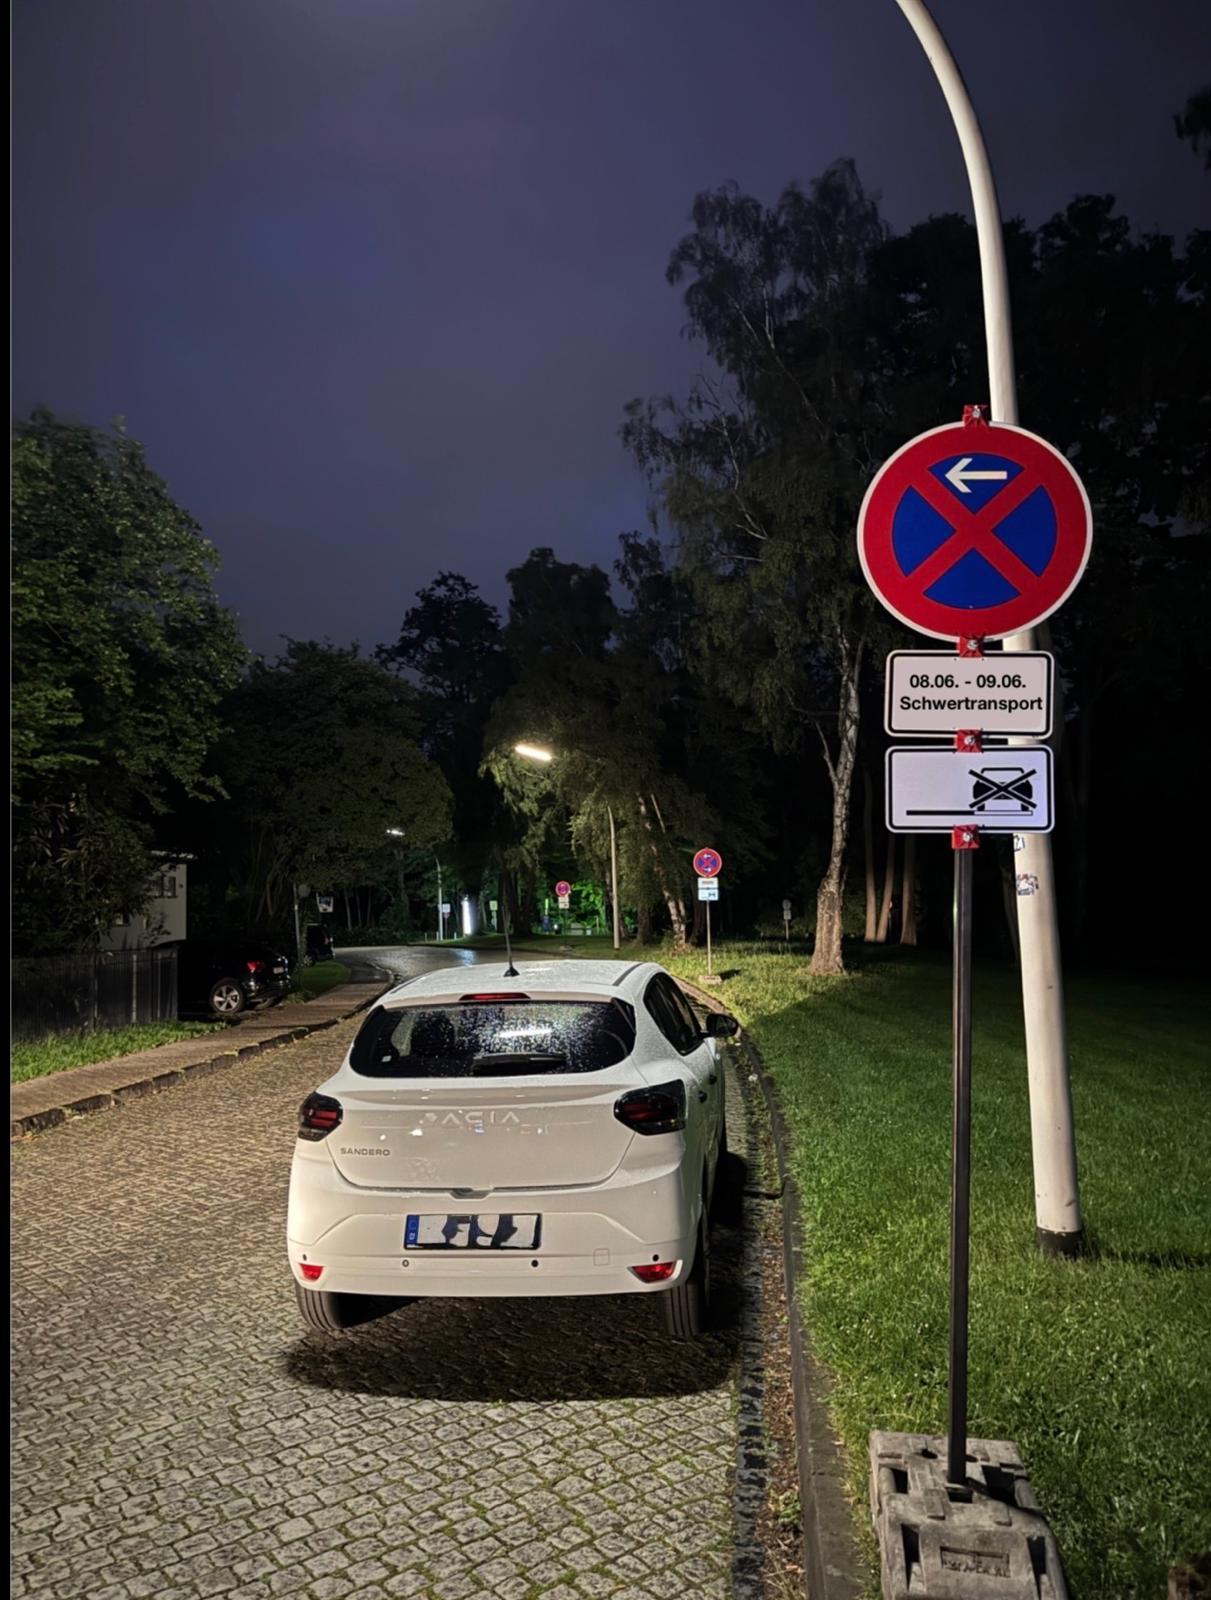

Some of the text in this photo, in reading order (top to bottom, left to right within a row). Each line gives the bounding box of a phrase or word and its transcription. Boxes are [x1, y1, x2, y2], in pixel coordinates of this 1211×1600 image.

[909, 674, 959, 688] 08.06.
[976, 674, 1026, 688] 09.06.
[900, 696, 1043, 713] Schwertransport
[340, 1147, 391, 1157] SANDERO
